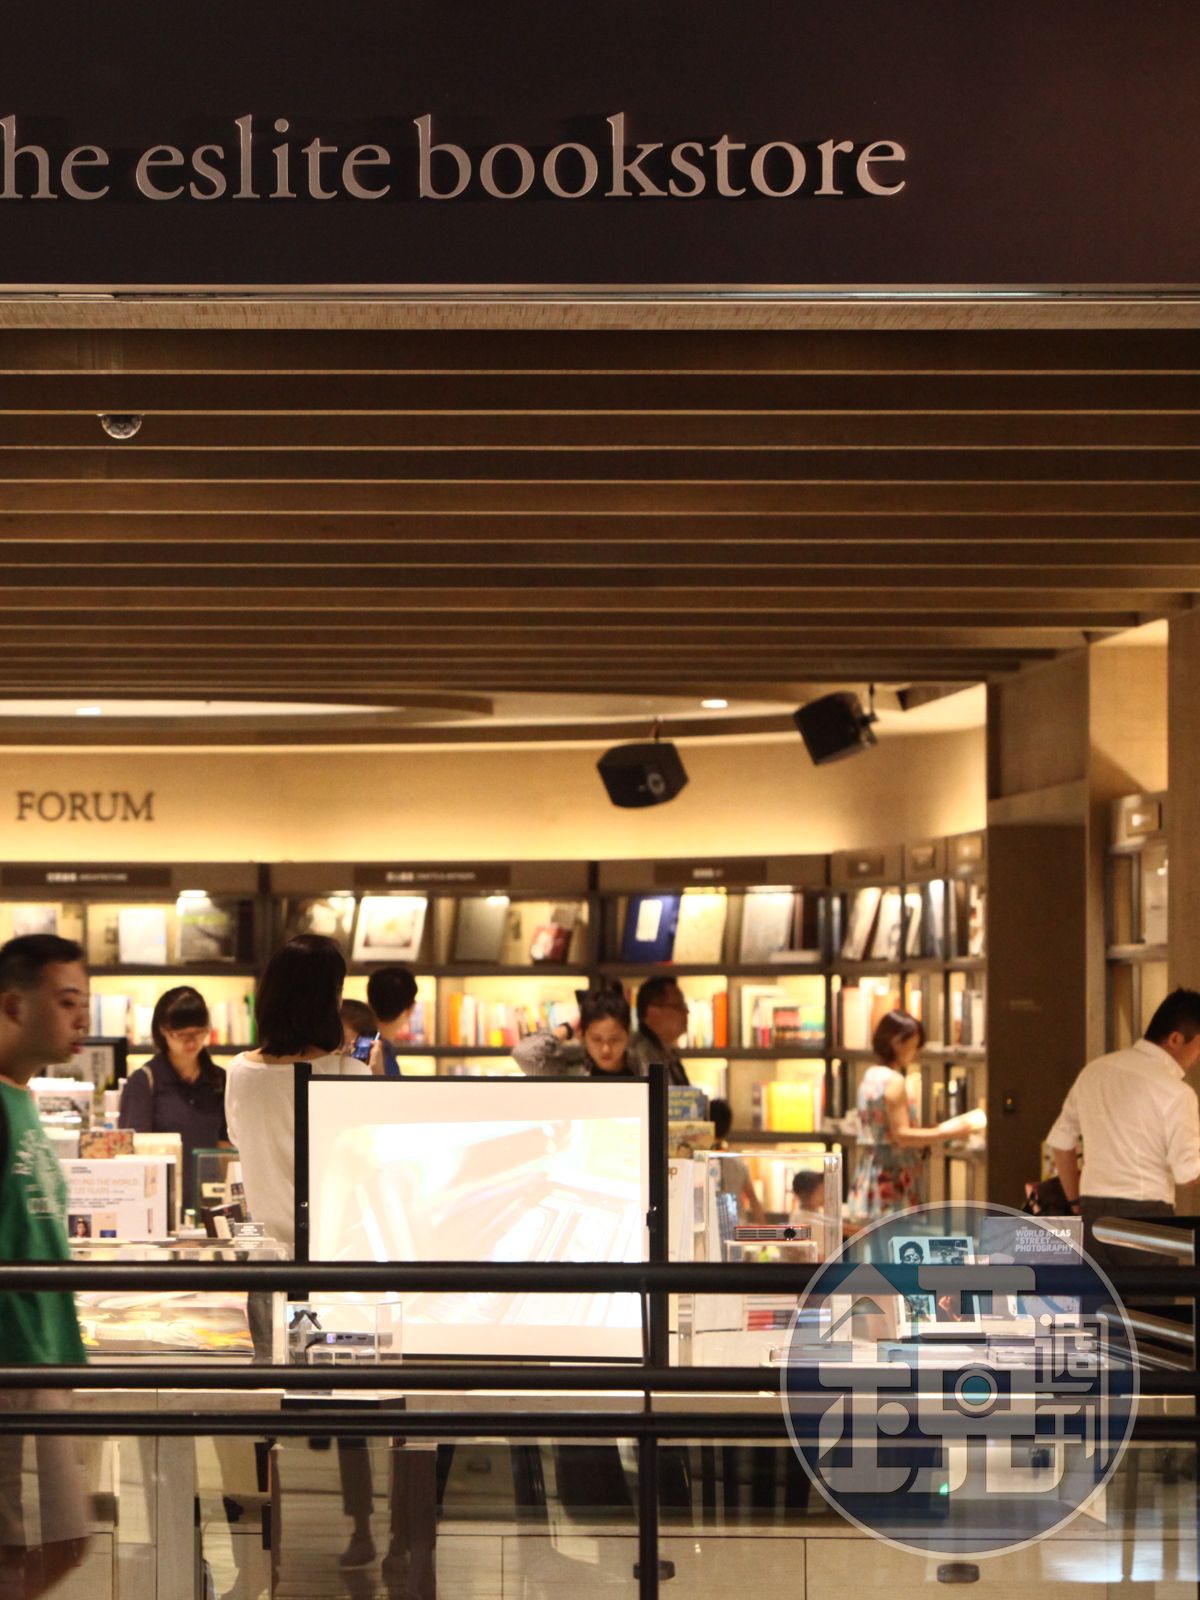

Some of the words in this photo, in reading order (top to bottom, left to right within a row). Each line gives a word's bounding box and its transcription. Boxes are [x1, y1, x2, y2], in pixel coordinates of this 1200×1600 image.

[135, 113, 391, 200] eslite
[413, 111, 907, 200] bookstore
[15, 790, 156, 822] FORUM
[1015, 1229, 1044, 1238] WORLD
[1046, 1228, 1072, 1238] ATLAS
[1015, 1244, 1074, 1253] PHOTOGRAPHY
